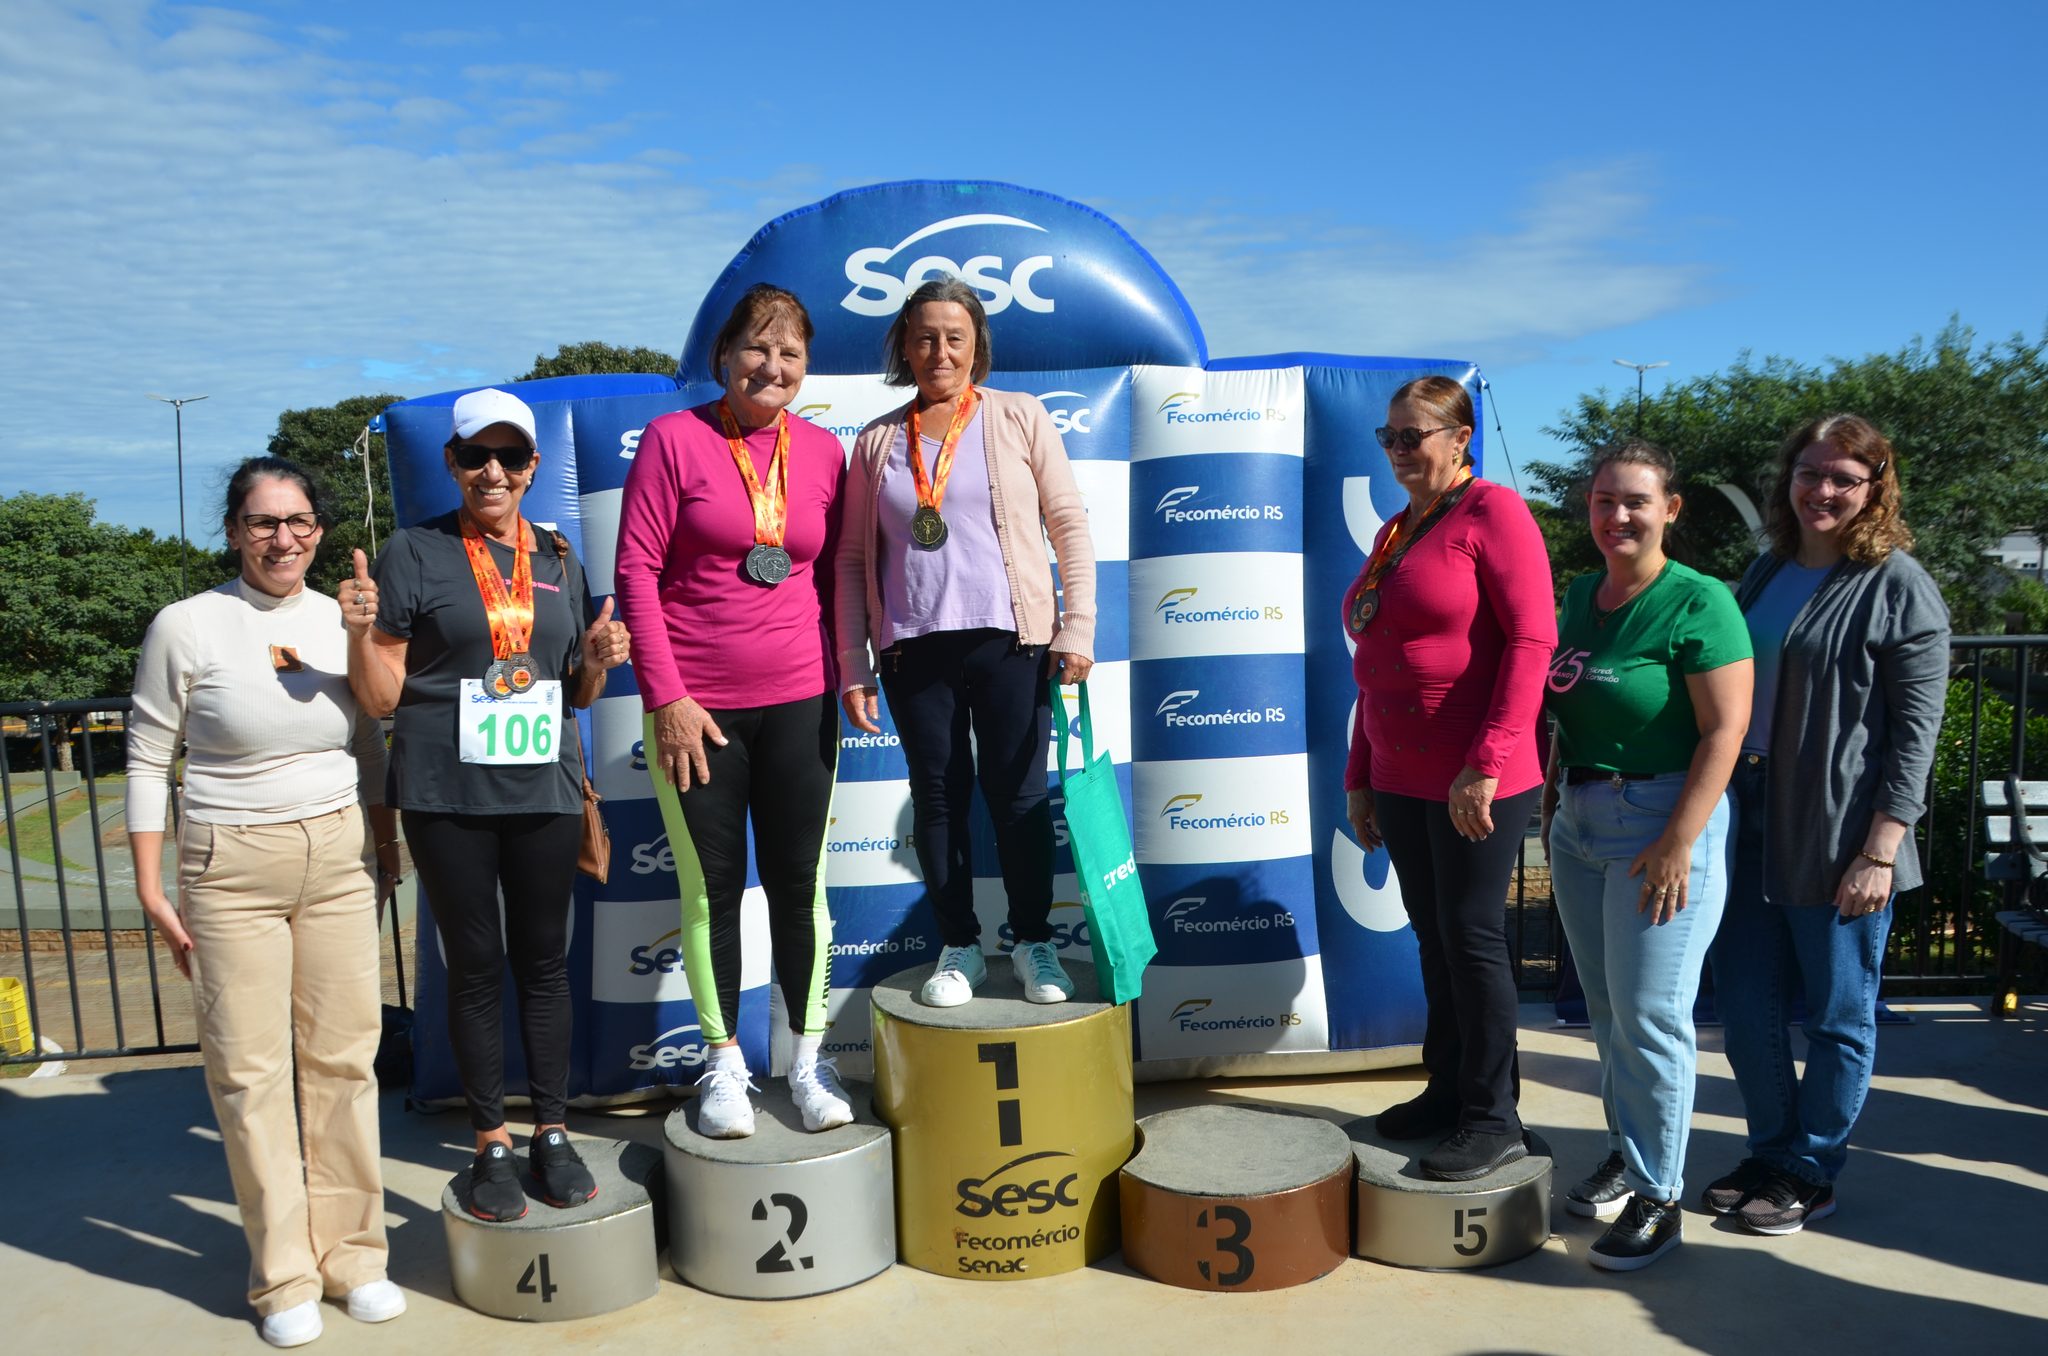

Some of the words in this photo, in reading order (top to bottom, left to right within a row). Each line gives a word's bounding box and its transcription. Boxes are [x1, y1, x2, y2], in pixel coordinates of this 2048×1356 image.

[1167, 408, 1261, 425] Fecomércio
[1266, 408, 1287, 422] RS
[1165, 505, 1260, 524] Fecomércio
[1264, 505, 1284, 520] RS
[1165, 606, 1260, 624] Fecomércio
[1264, 606, 1284, 620] RS
[1585, 673, 1620, 683] Conexão
[1589, 666, 1614, 675] Sicredi
[1166, 709, 1261, 727] Fecomércio
[1266, 707, 1286, 722] RS
[477, 713, 552, 757] 106
[841, 733, 901, 748] mércio
[1170, 812, 1265, 830] Fecomércio
[1270, 810, 1289, 825] RS
[827, 837, 900, 852] comércio
[905, 834, 916, 849] R
[630, 843, 677, 875] Se
[1103, 851, 1136, 890] cred
[1174, 915, 1270, 933] Fecomércio
[1274, 912, 1295, 927] RS
[831, 940, 899, 955] omércio
[905, 936, 926, 951] RS
[1180, 1014, 1275, 1032] Fecomércio
[1280, 1012, 1301, 1026] RS
[977, 1041, 1022, 1147] 1
[955, 1173, 1079, 1218] Sesc
[751, 1192, 814, 1273] 2
[956, 1224, 1080, 1251] Fecomércio
[1453, 1207, 1488, 1256] 5
[1196, 1204, 1255, 1287] 3
[958, 1256, 1026, 1274] Senac
[516, 1253, 557, 1303] 4
